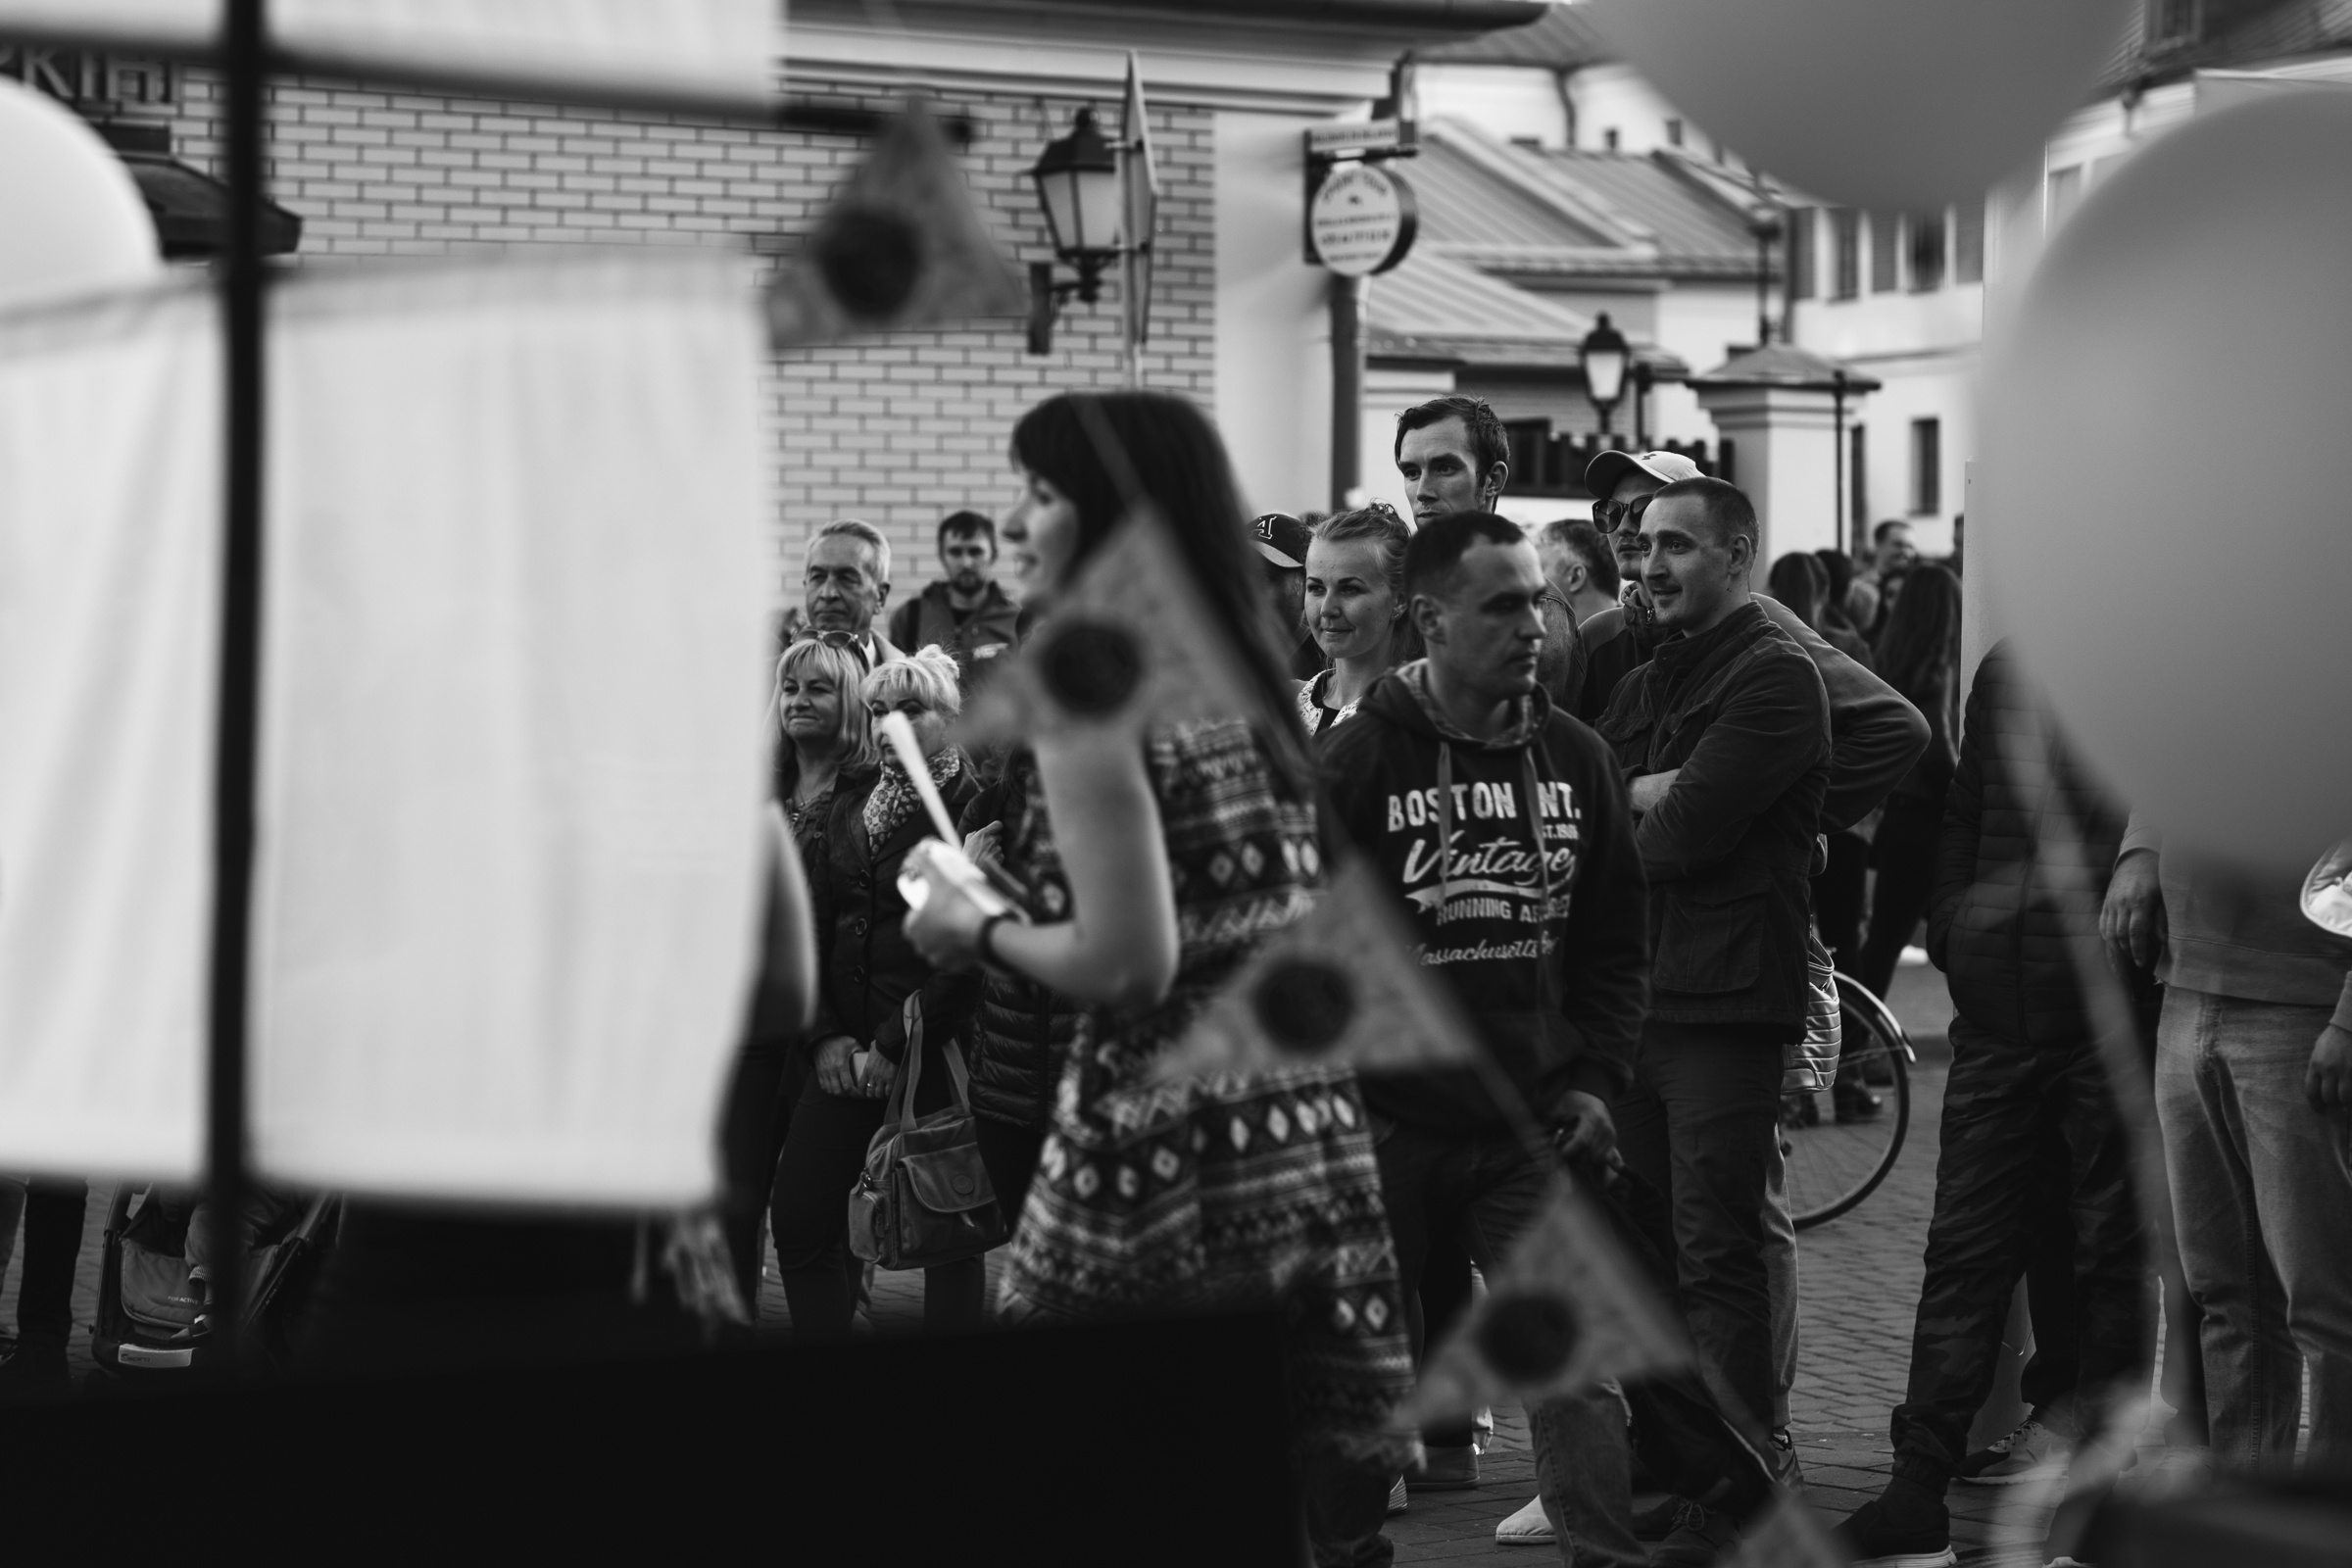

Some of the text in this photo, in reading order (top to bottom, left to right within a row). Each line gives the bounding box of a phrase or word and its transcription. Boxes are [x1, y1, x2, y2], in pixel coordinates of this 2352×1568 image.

[1388, 781, 1518, 832] BOSTON
[1402, 829, 1577, 891] Vintage
[1436, 898, 1512, 926] RUNNING
